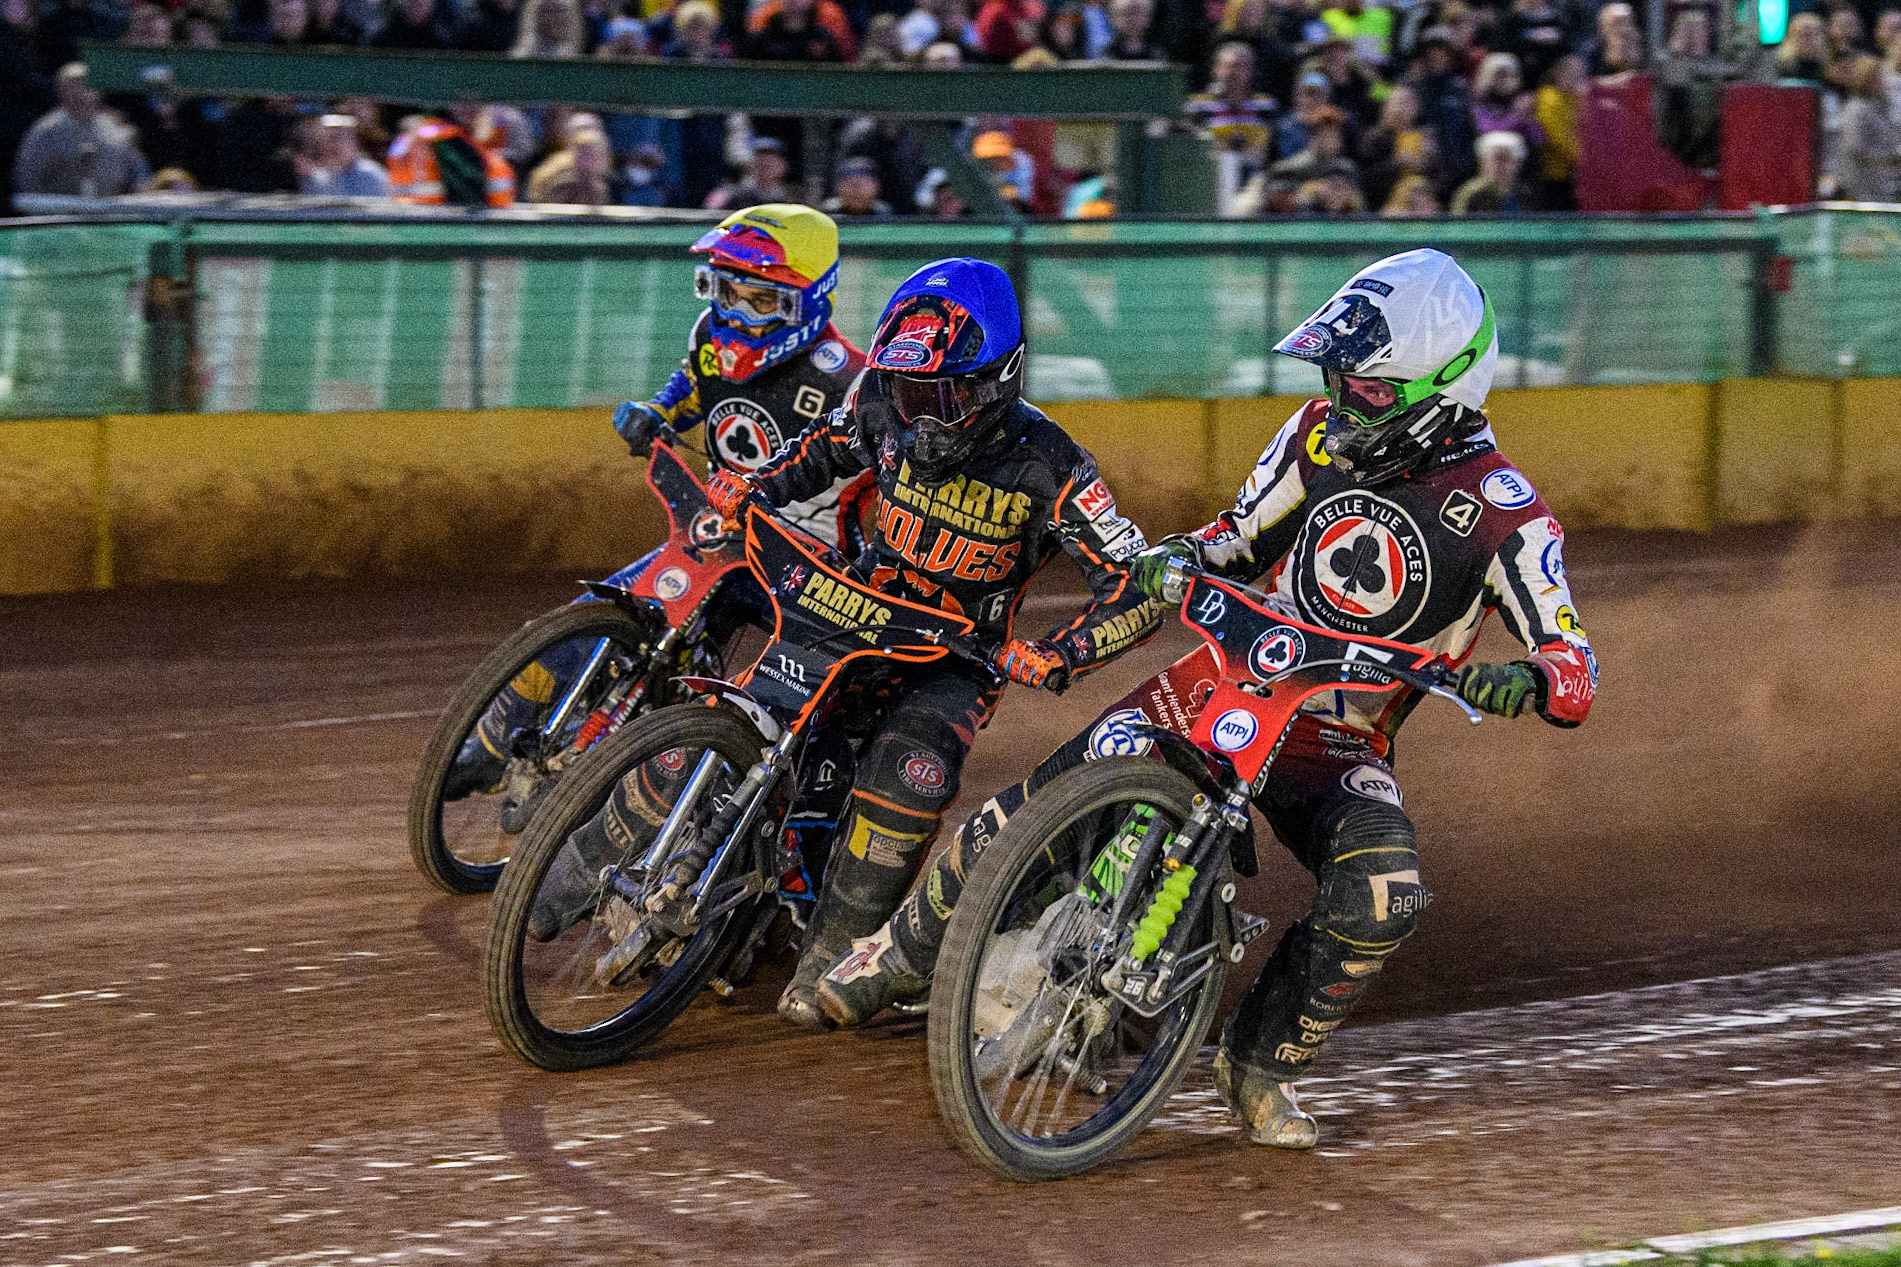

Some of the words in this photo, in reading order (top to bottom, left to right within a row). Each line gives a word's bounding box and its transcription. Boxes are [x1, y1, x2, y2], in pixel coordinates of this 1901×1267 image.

[884, 350, 922, 360] STS
[801, 393, 818, 413] 6
[711, 403, 737, 427] BELLE
[739, 404, 761, 421] VUE
[760, 420, 781, 449] ACES
[898, 458, 1031, 526] RRYS
[1079, 482, 1108, 511] NG
[1494, 473, 1525, 498] ATPI
[1445, 502, 1475, 529] 4
[1314, 499, 1363, 529] BELLE
[1370, 503, 1402, 532] VUE
[1400, 535, 1423, 583] ACES
[803, 571, 892, 633] PARRYS
[1311, 595, 1369, 632] MANCHESTER
[797, 594, 878, 645] INTERNATIOAL
[1090, 596, 1160, 649] PARRYS
[1260, 628, 1280, 644] BELLE
[1282, 628, 1296, 638] VUE
[1294, 638, 1303, 656] ACES
[759, 663, 787, 686] WESSEX
[783, 676, 812, 698] MARINE
[1150, 689, 1173, 730] Tankers
[1219, 721, 1249, 740] ATPI
[911, 763, 939, 783] STS
[1359, 779, 1397, 798] ATPI
